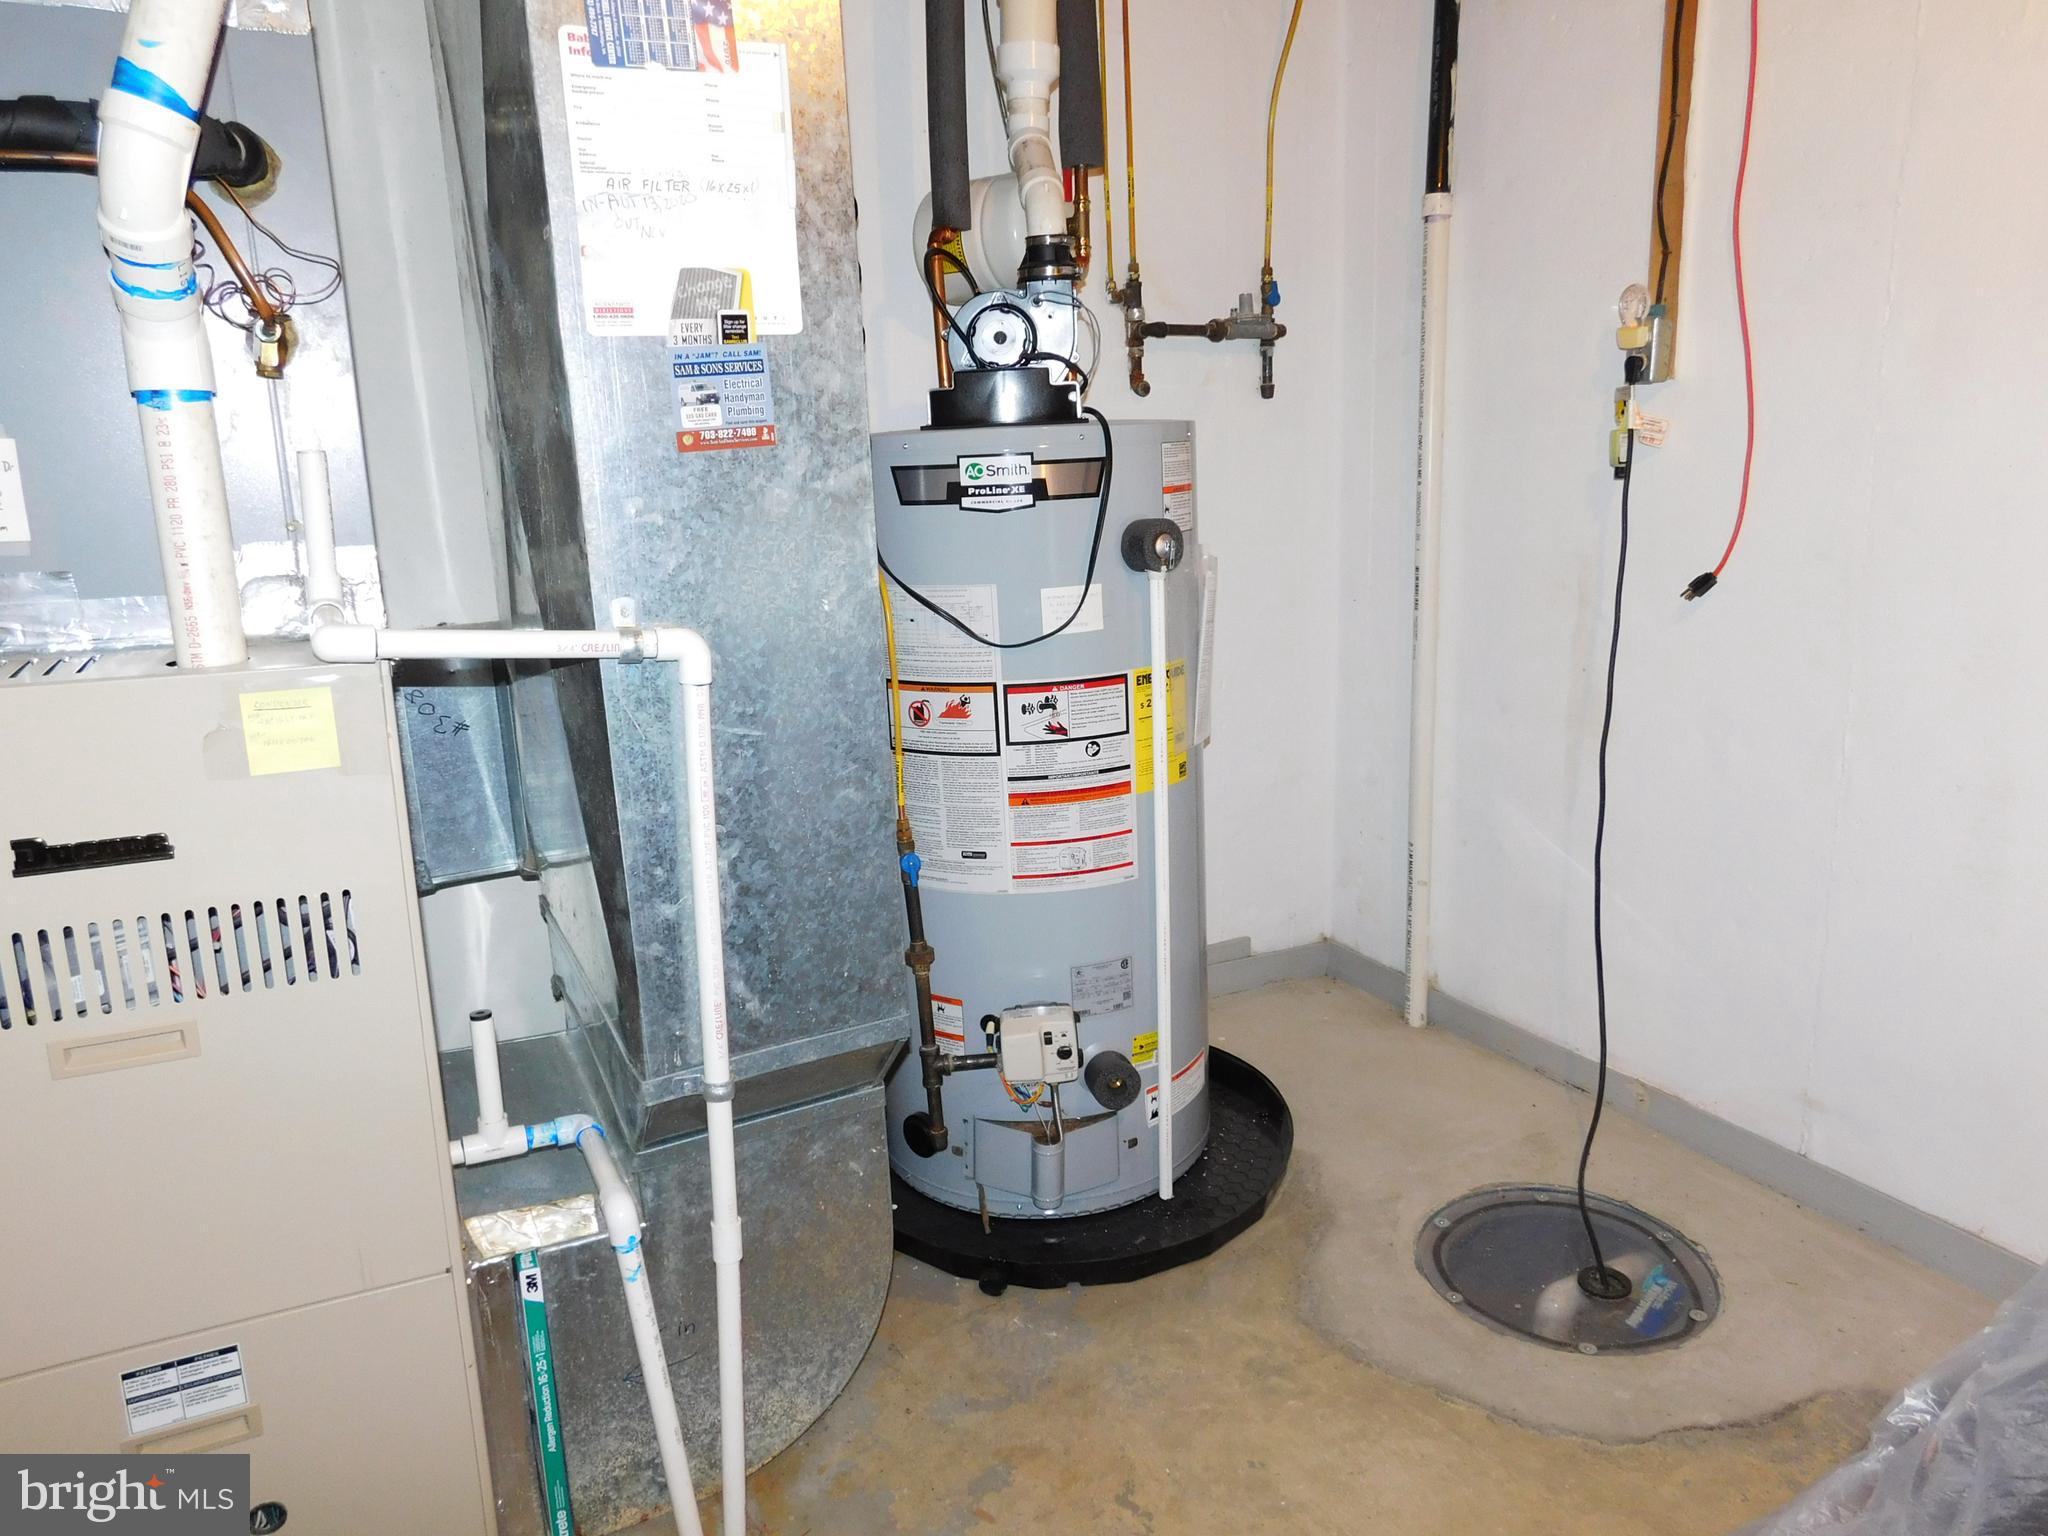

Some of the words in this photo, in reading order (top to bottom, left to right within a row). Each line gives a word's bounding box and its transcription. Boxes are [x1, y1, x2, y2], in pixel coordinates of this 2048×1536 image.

[606, 177, 631, 190] AIR
[643, 179, 690, 192] FILTER
[680, 322, 704, 334] EVERY
[673, 335, 679, 345] 3
[681, 335, 713, 345] MONTHS
[674, 364, 694, 376] SAM
[693, 365, 700, 375] &
[700, 363, 724, 375] SONS
[724, 361, 763, 373] SERVICES
[724, 378, 763, 390] Electrical
[724, 393, 765, 404] Handyman
[727, 406, 765, 417] Plumbing
[159, 453, 174, 470] PSI
[162, 475, 178, 493] 280
[166, 496, 180, 509] PR
[170, 514, 184, 536] 1120
[174, 542, 188, 558] PVC
[183, 615, 202, 649] D-2665
[526, 1273, 538, 1293] 3M
[540, 1385, 553, 1421] Reduction
[544, 1422, 557, 1452] Allergen
